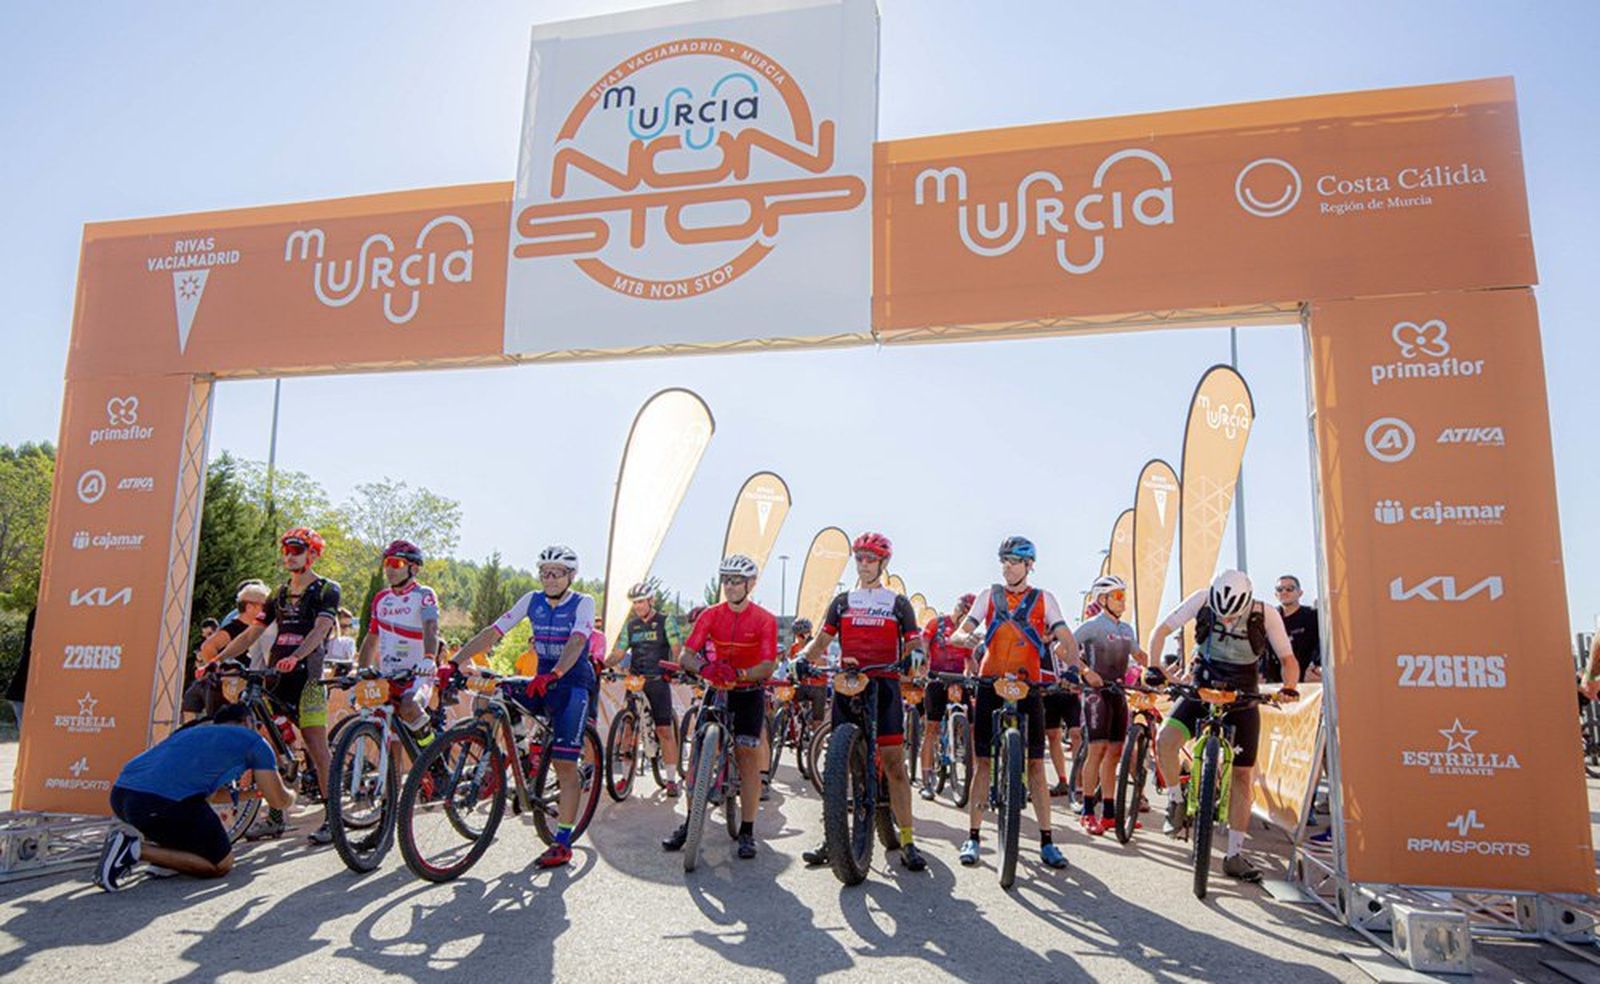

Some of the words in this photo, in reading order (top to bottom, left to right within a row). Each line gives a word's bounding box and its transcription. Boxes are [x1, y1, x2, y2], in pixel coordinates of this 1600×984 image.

[590, 65, 625, 100] RIVAS
[626, 41, 723, 70] VACIAMADRID
[741, 50, 786, 85] MURCIA
[550, 119, 835, 199] NON
[1316, 174, 1391, 197] Costa
[1397, 162, 1488, 190] Cálida
[1319, 199, 1365, 216] Región
[1367, 198, 1384, 211] de
[1387, 194, 1433, 209] Murcia
[513, 175, 867, 260] STOP
[174, 237, 215, 254] RIVAS
[147, 249, 240, 272] VACIAMADRID
[614, 275, 645, 296] MTB
[650, 282, 689, 298] NON
[694, 264, 735, 292] STOP
[1371, 357, 1485, 385] primaflor
[89, 426, 154, 446] primaflor
[1436, 426, 1505, 443] ATIKA
[1410, 500, 1506, 525] cajamar
[92, 532, 145, 549] cajamar
[63, 645, 122, 670] 226ERS
[1396, 654, 1507, 688] 226ERS
[54, 715, 116, 728] ESTRELLA
[1402, 751, 1521, 769] ESTRELLA
[1407, 837, 1530, 857] RPMSPORTS
